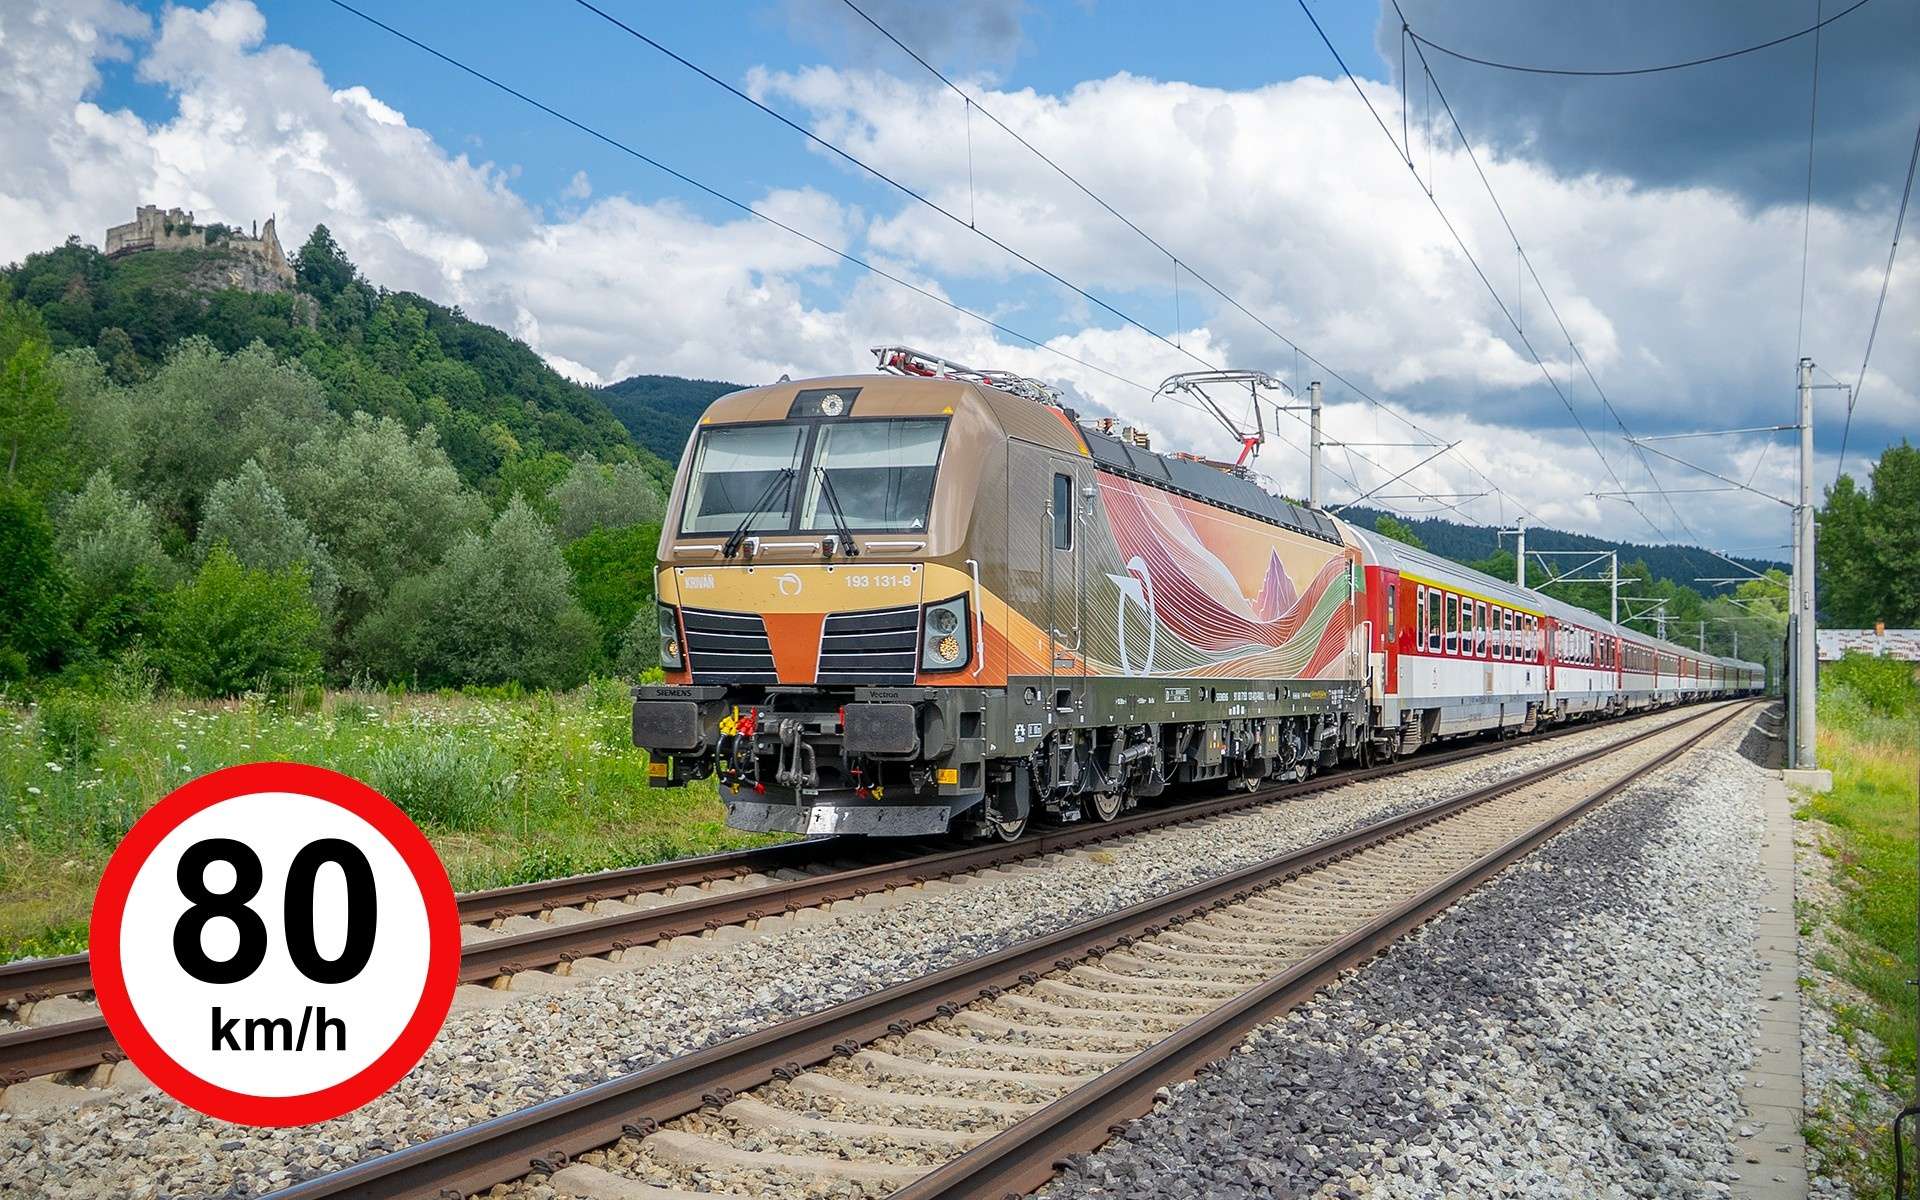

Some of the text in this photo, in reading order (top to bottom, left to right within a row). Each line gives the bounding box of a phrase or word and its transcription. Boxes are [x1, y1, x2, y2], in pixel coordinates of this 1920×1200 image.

[846, 575, 911, 587] 193 131-8
[656, 689, 692, 697] SIEMENS
